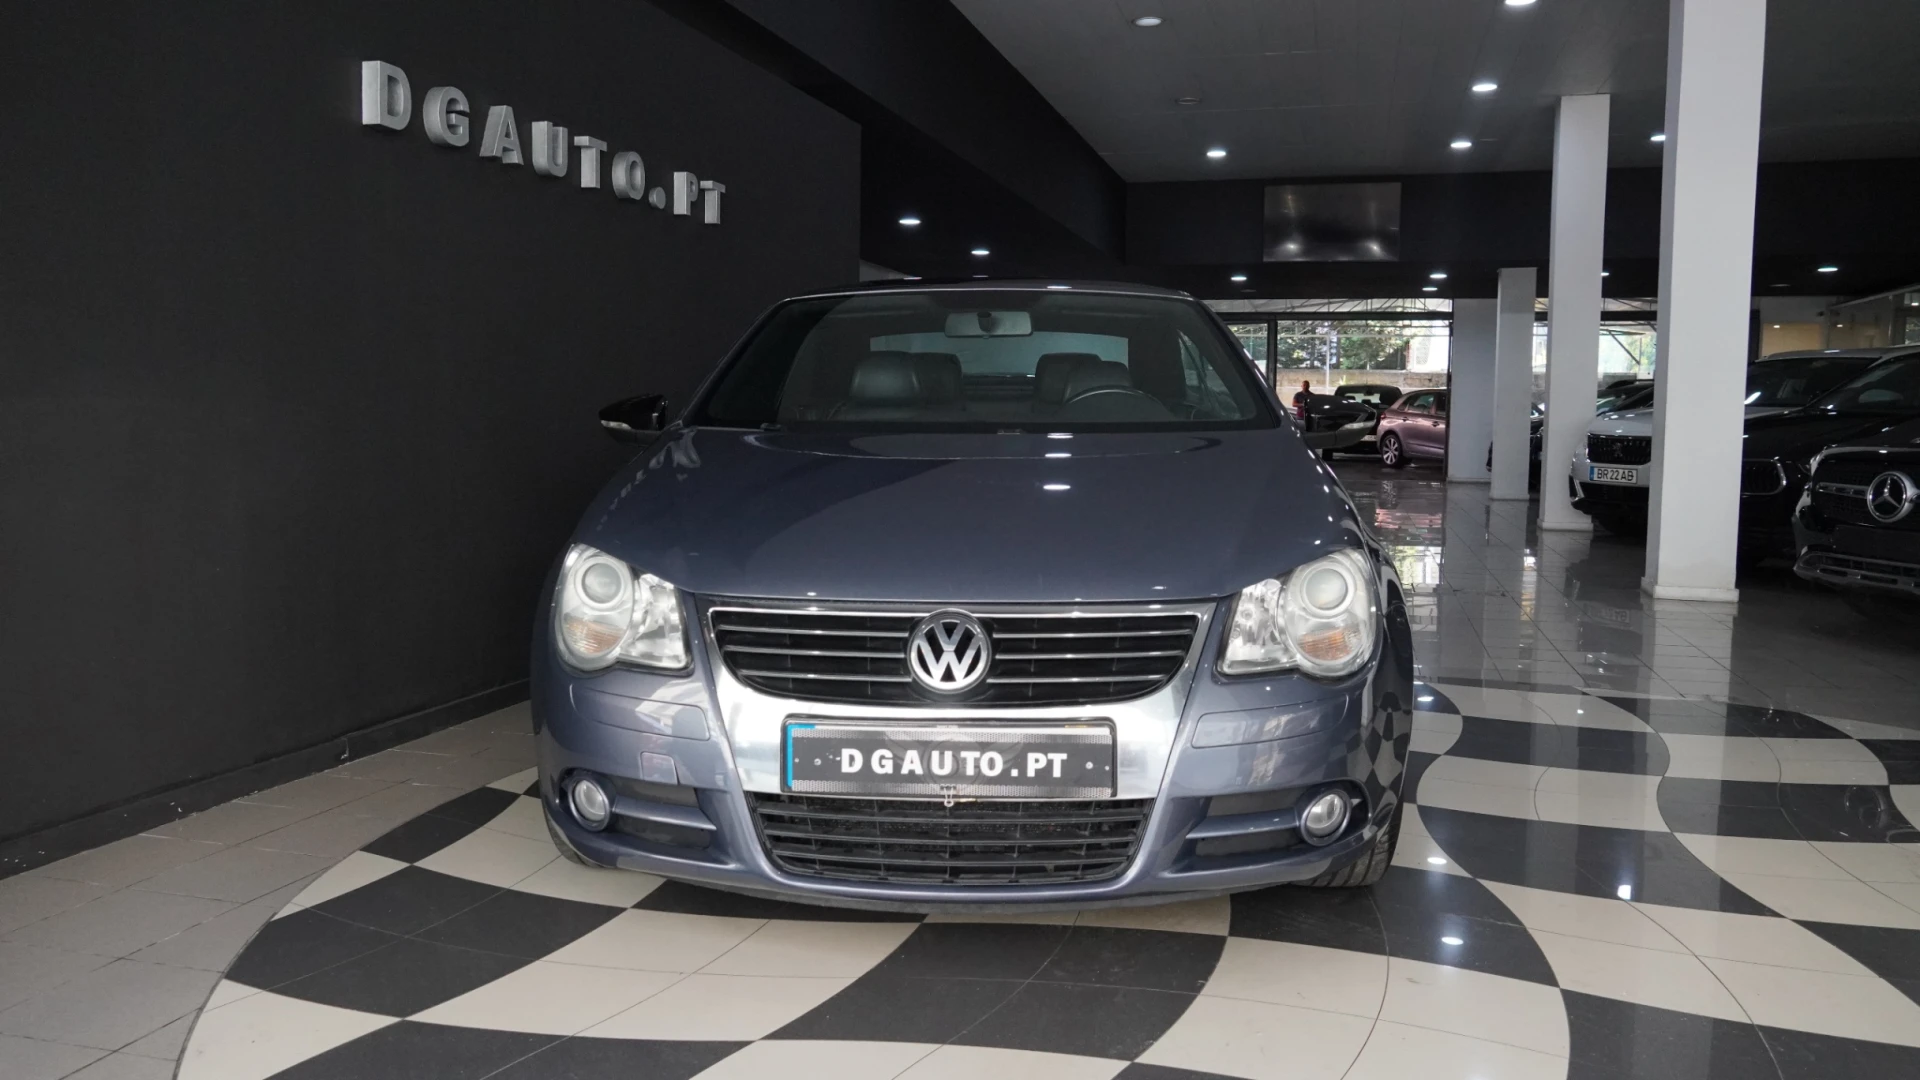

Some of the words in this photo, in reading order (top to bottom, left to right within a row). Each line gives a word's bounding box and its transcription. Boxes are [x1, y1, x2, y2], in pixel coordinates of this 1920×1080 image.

[361, 60, 726, 224] DGAUTO.PT
[1597, 468, 1609, 480] BR
[1609, 469, 1620, 481] 22
[841, 748, 1068, 778] DGAUTO.PT
